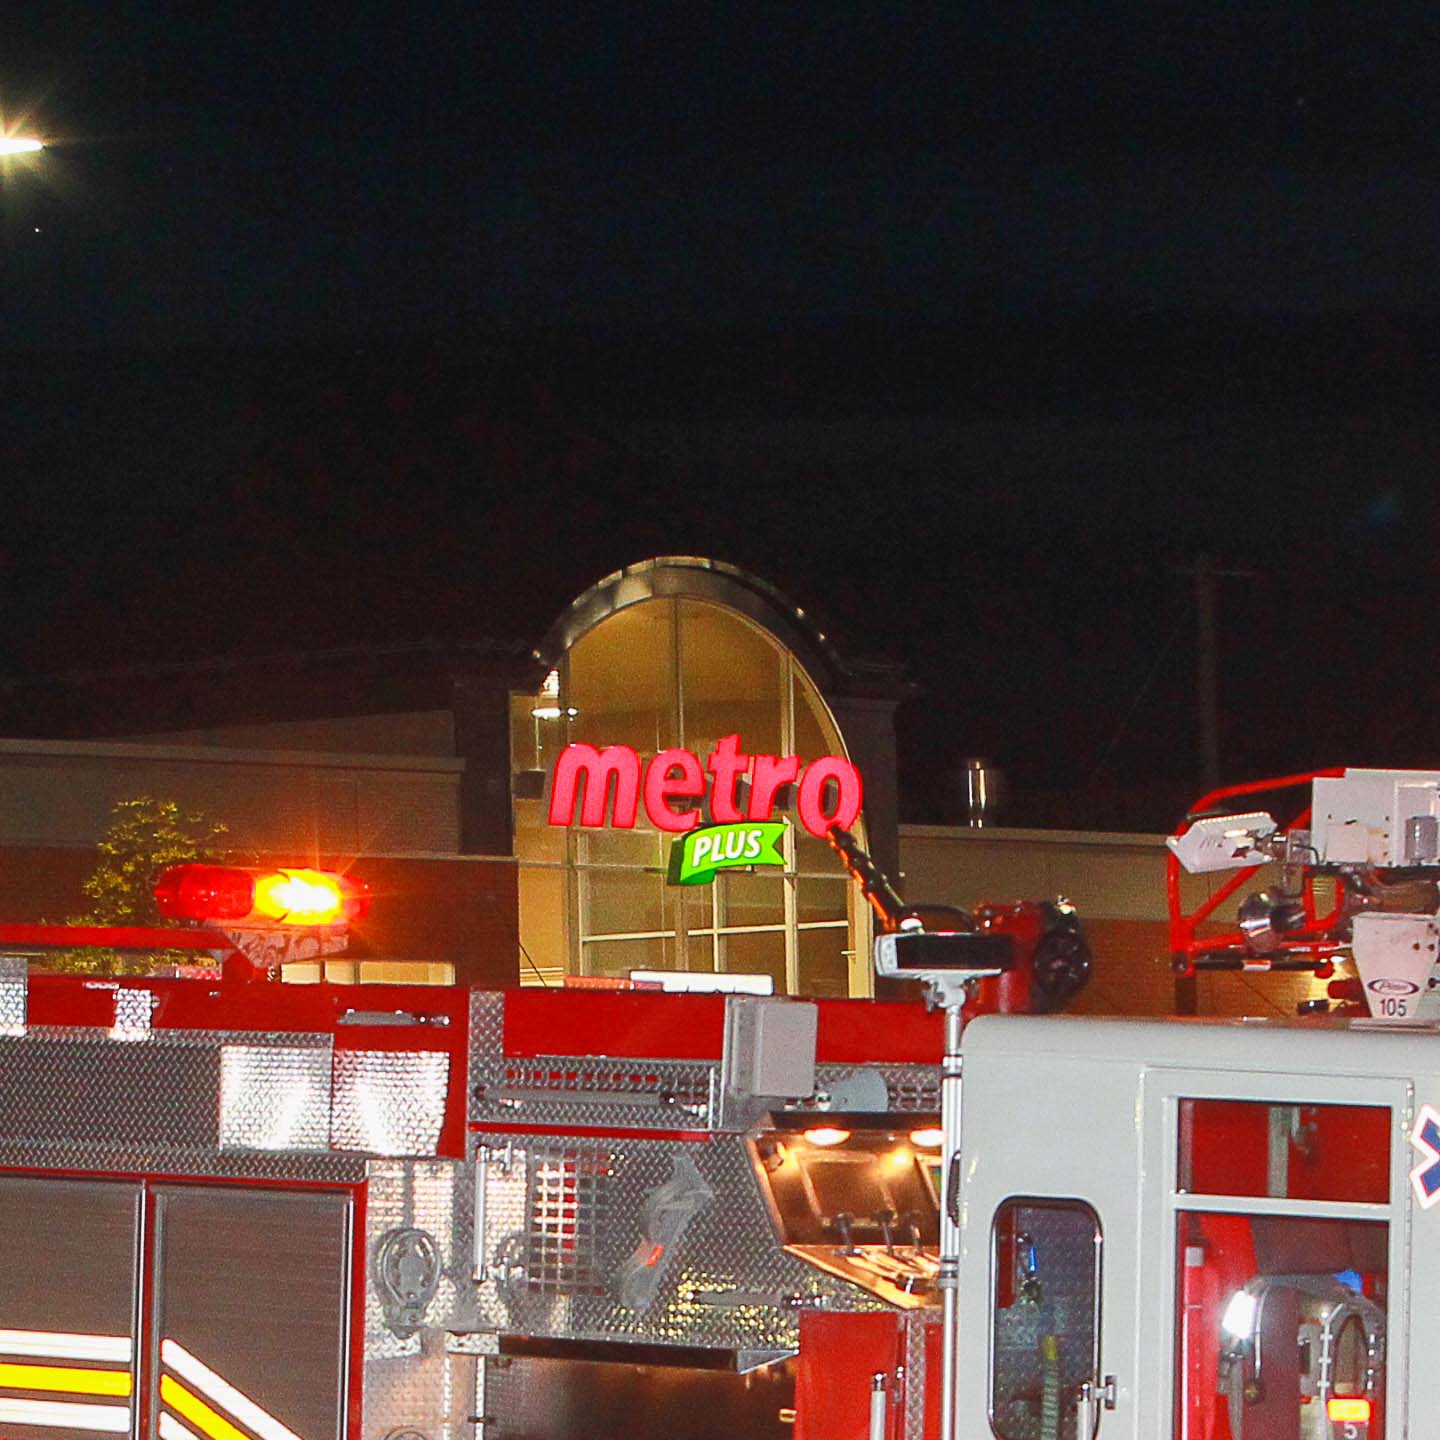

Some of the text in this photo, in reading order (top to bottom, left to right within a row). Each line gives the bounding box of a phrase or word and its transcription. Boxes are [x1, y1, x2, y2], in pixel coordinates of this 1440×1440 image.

[548, 734, 863, 838] metro
[692, 829, 763, 867] PLUS
[1380, 998, 1407, 1017] 105
